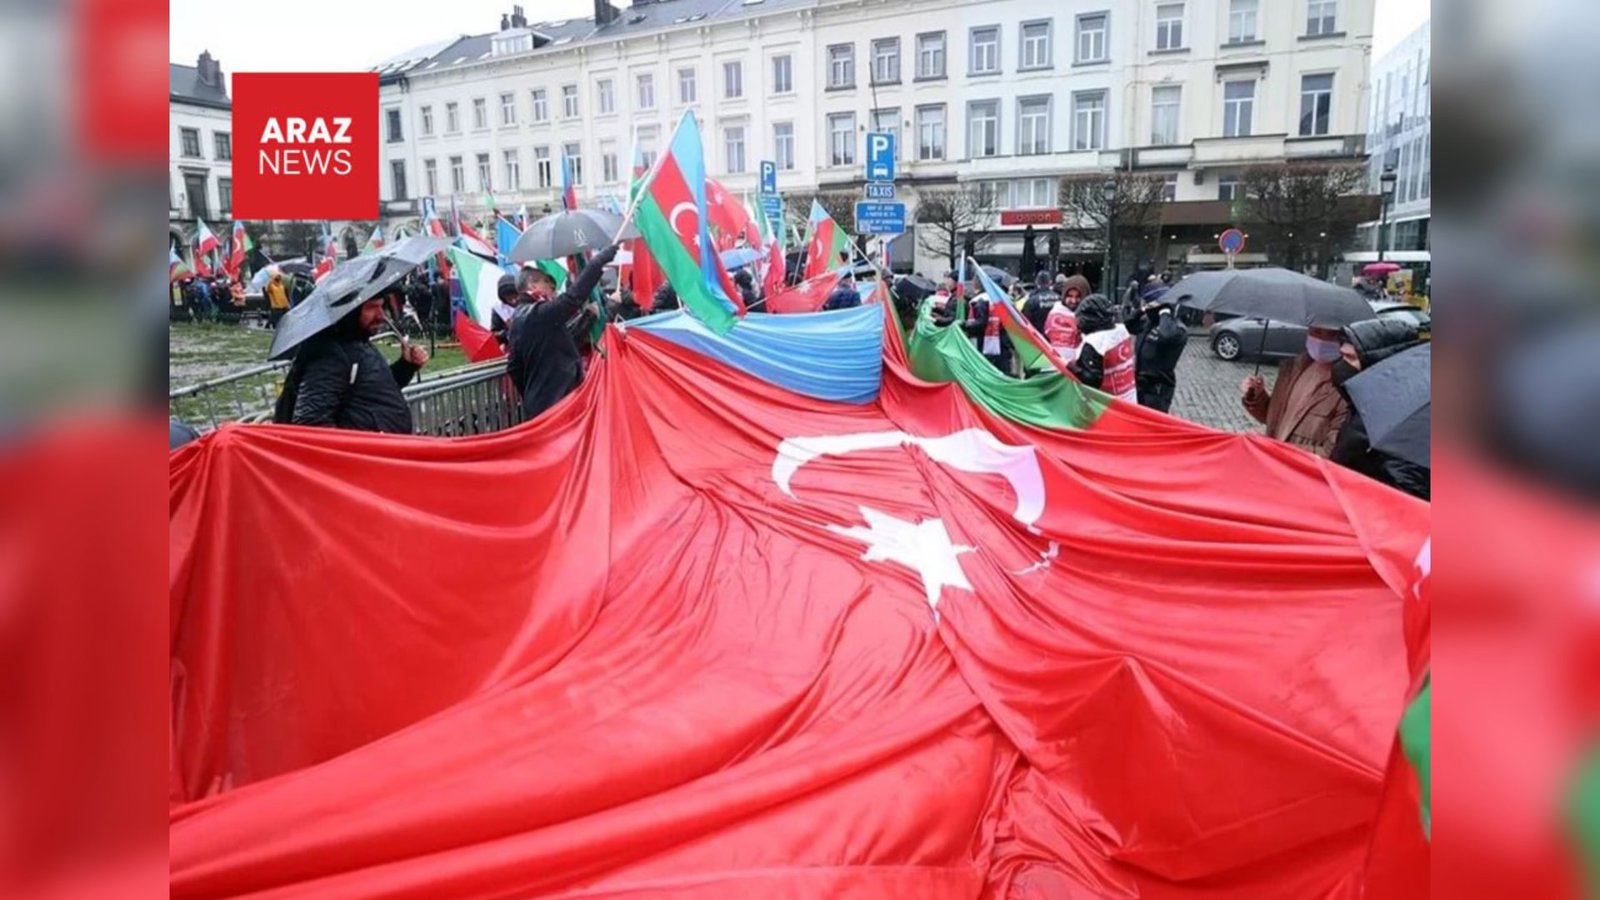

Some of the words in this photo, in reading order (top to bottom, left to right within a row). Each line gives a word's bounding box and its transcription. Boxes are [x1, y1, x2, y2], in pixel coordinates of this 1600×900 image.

[872, 136, 888, 161] P
[763, 163, 773, 181] P
[868, 186, 893, 197] TAXIS
